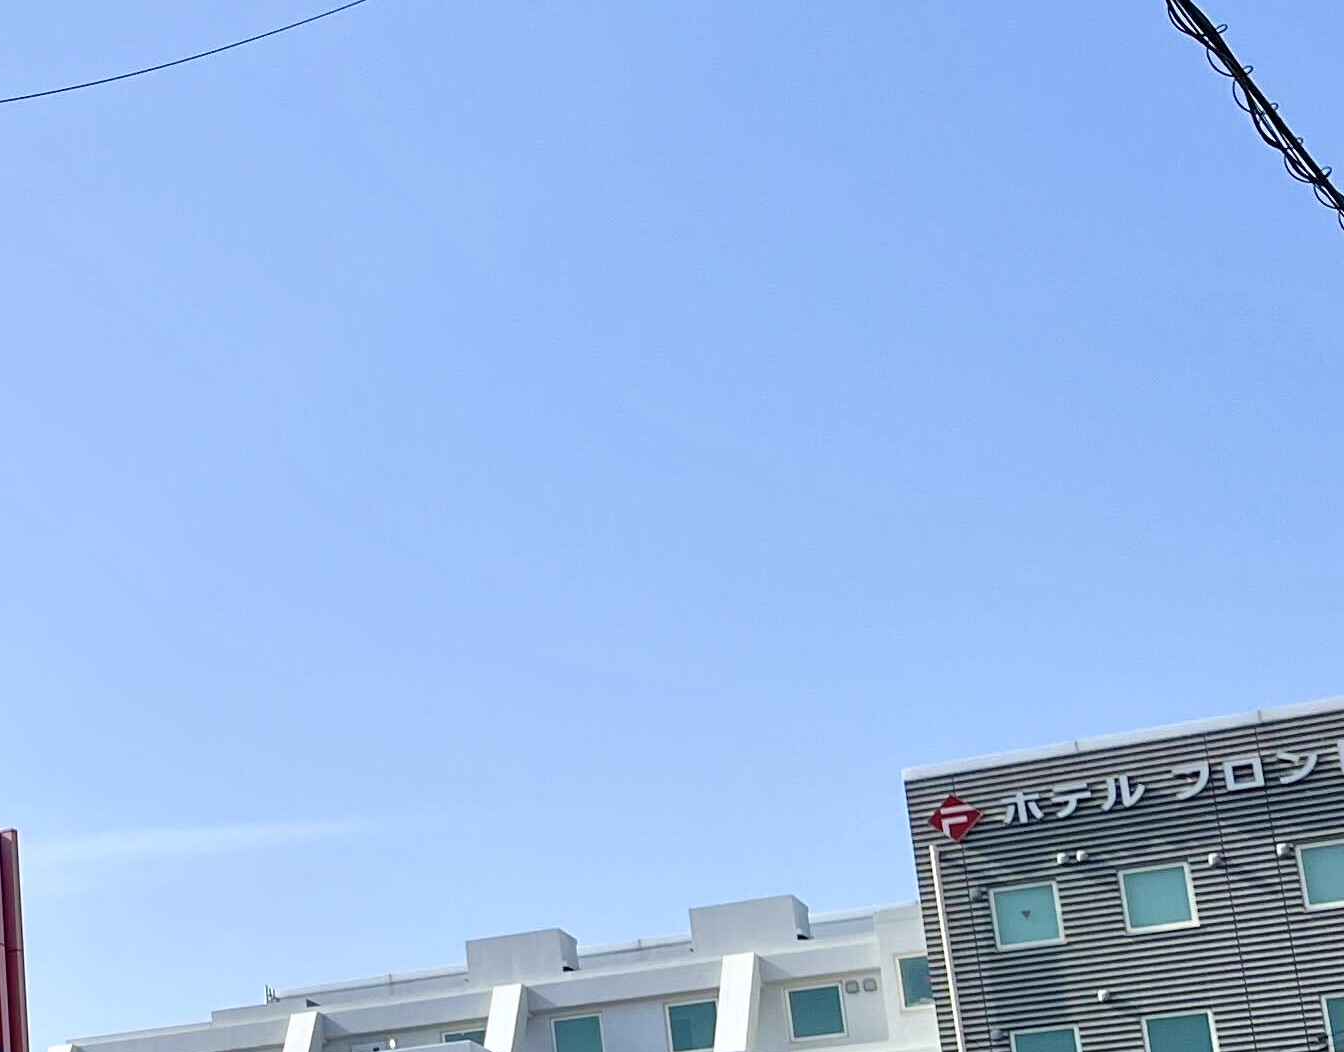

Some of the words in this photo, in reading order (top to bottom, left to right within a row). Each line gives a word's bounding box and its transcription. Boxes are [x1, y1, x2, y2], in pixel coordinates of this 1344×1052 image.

[1001, 775, 1145, 825] ホテル
[1172, 740, 1344, 800] フロン
